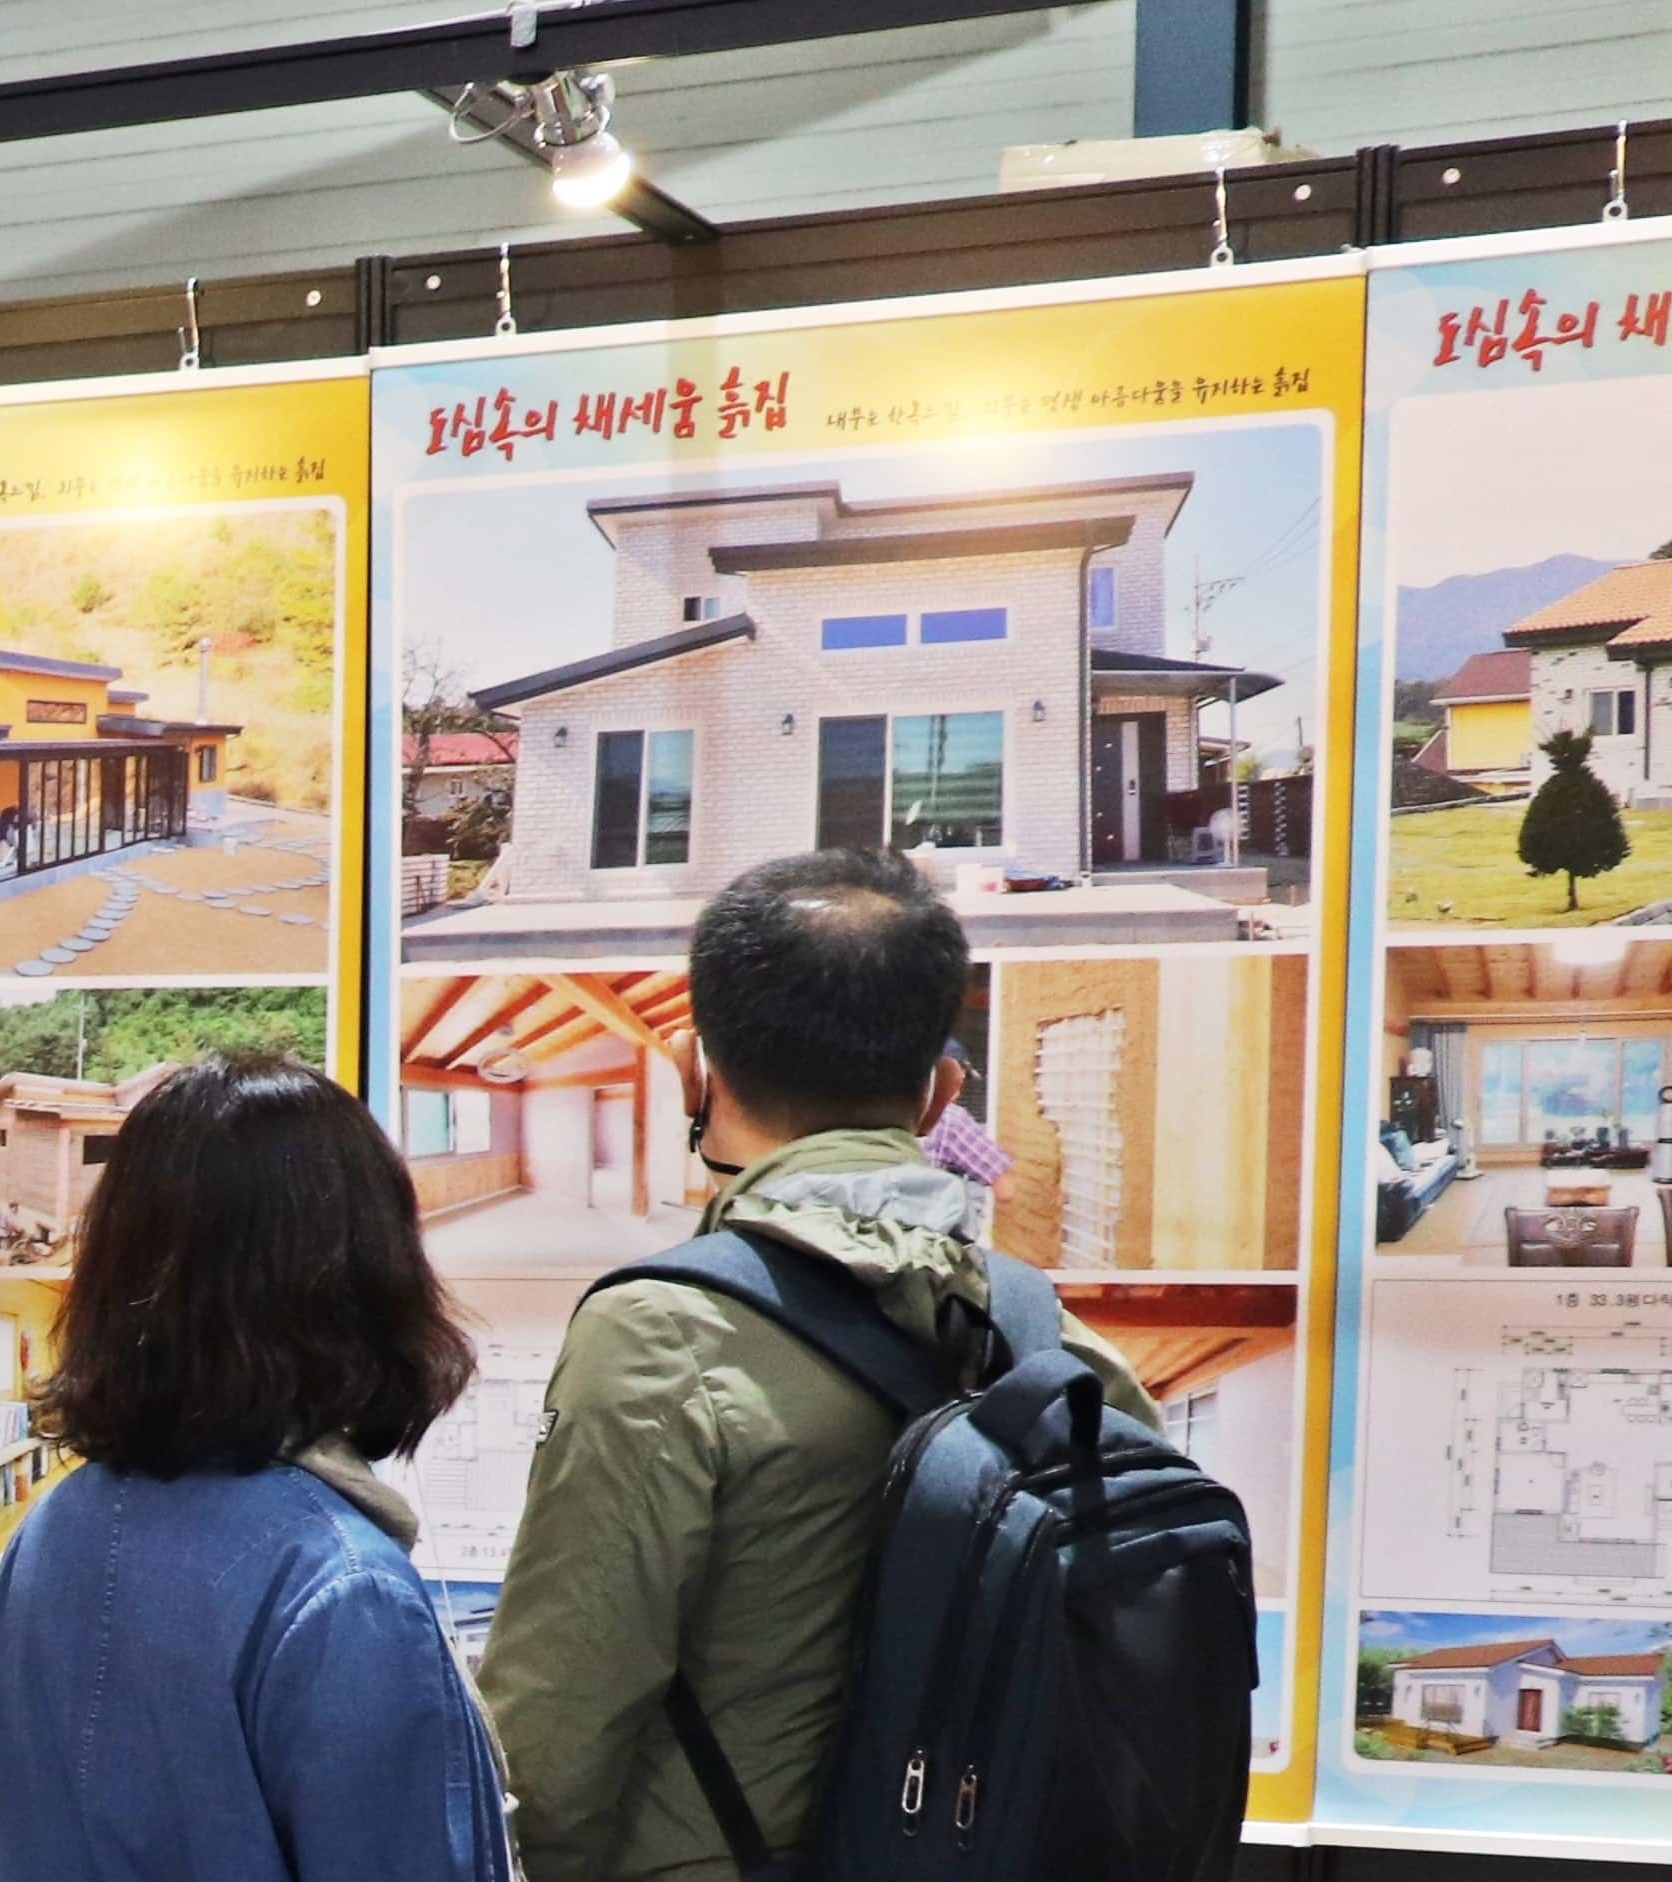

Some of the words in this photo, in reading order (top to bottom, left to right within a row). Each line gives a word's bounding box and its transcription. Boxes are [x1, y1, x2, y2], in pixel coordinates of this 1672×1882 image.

[1433, 288, 1600, 372] 도심속의
[426, 387, 558, 460] 도심속의
[573, 378, 704, 440] 채세움
[717, 365, 791, 439] 흙집
[1090, 381, 1183, 409] 아름다움을
[1192, 376, 1265, 404] 유지하는
[1273, 366, 1311, 397] 흙집
[296, 456, 327, 484] 흙집
